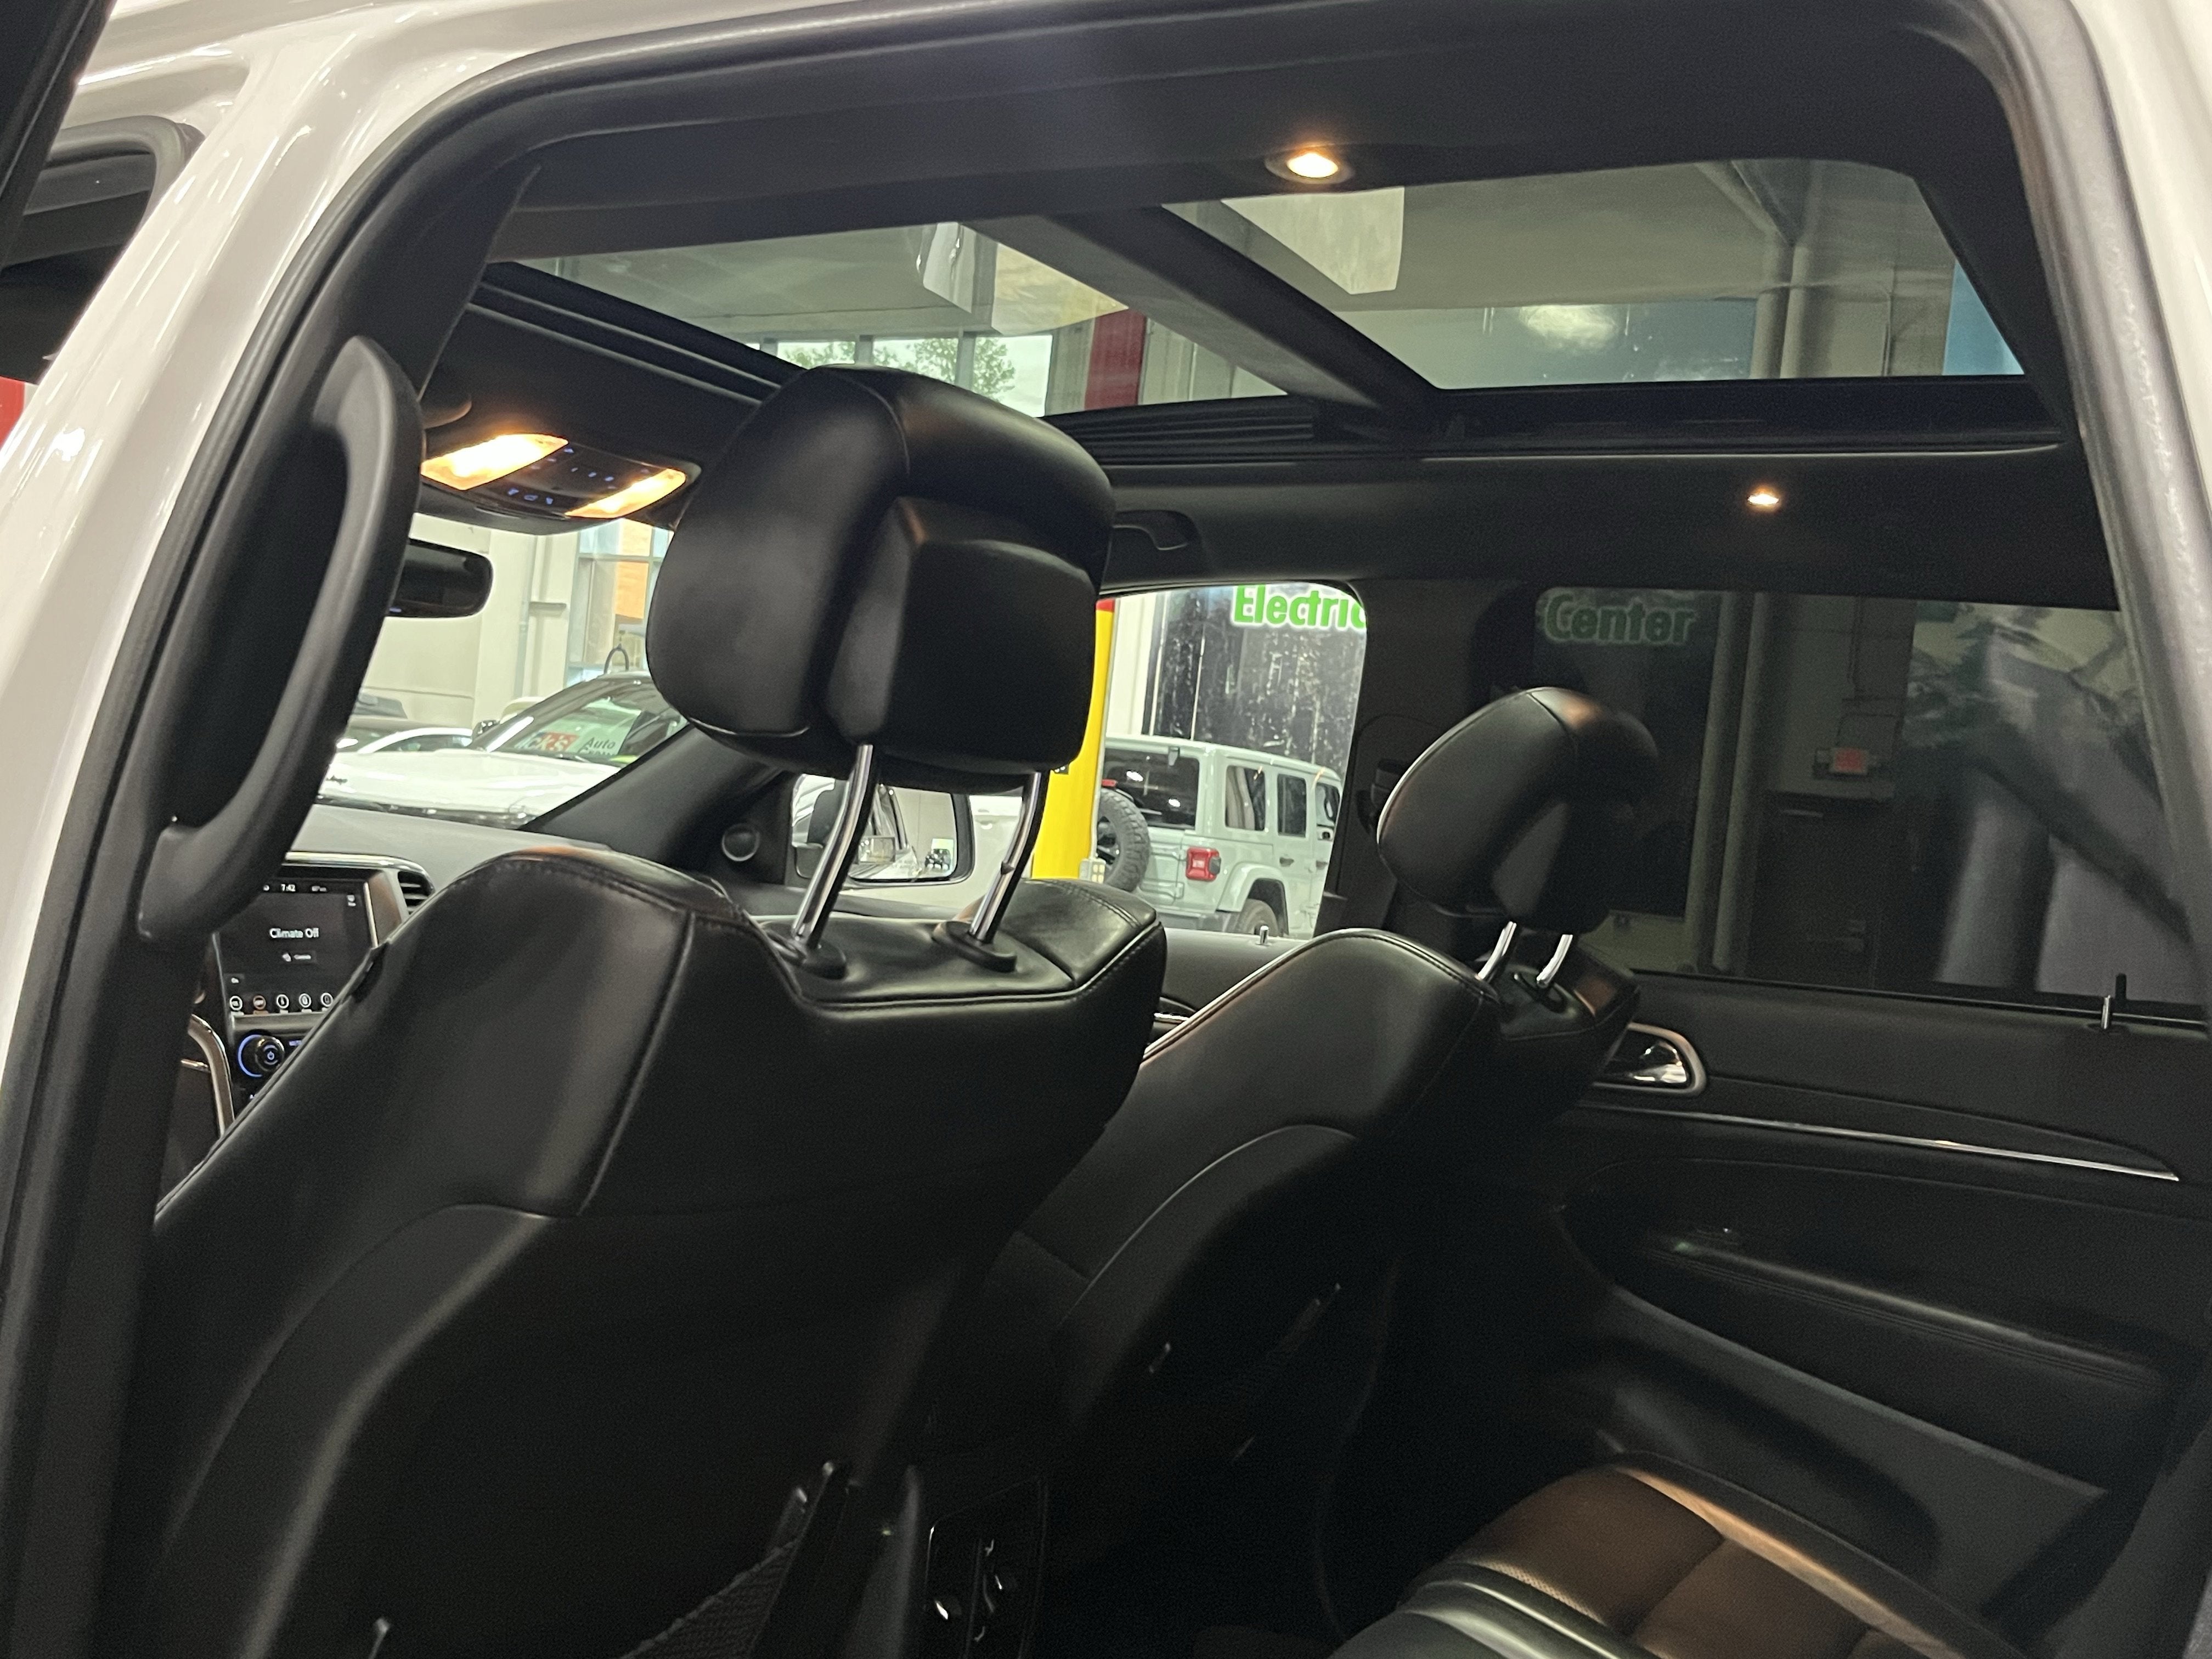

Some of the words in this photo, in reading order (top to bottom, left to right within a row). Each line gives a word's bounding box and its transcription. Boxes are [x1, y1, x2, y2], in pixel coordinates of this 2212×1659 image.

[1234, 585, 1365, 629] Electric
[1547, 594, 1695, 642] Center
[583, 737, 616, 749] Auto
[269, 928, 303, 938] Climate
[305, 927, 319, 938] Off
